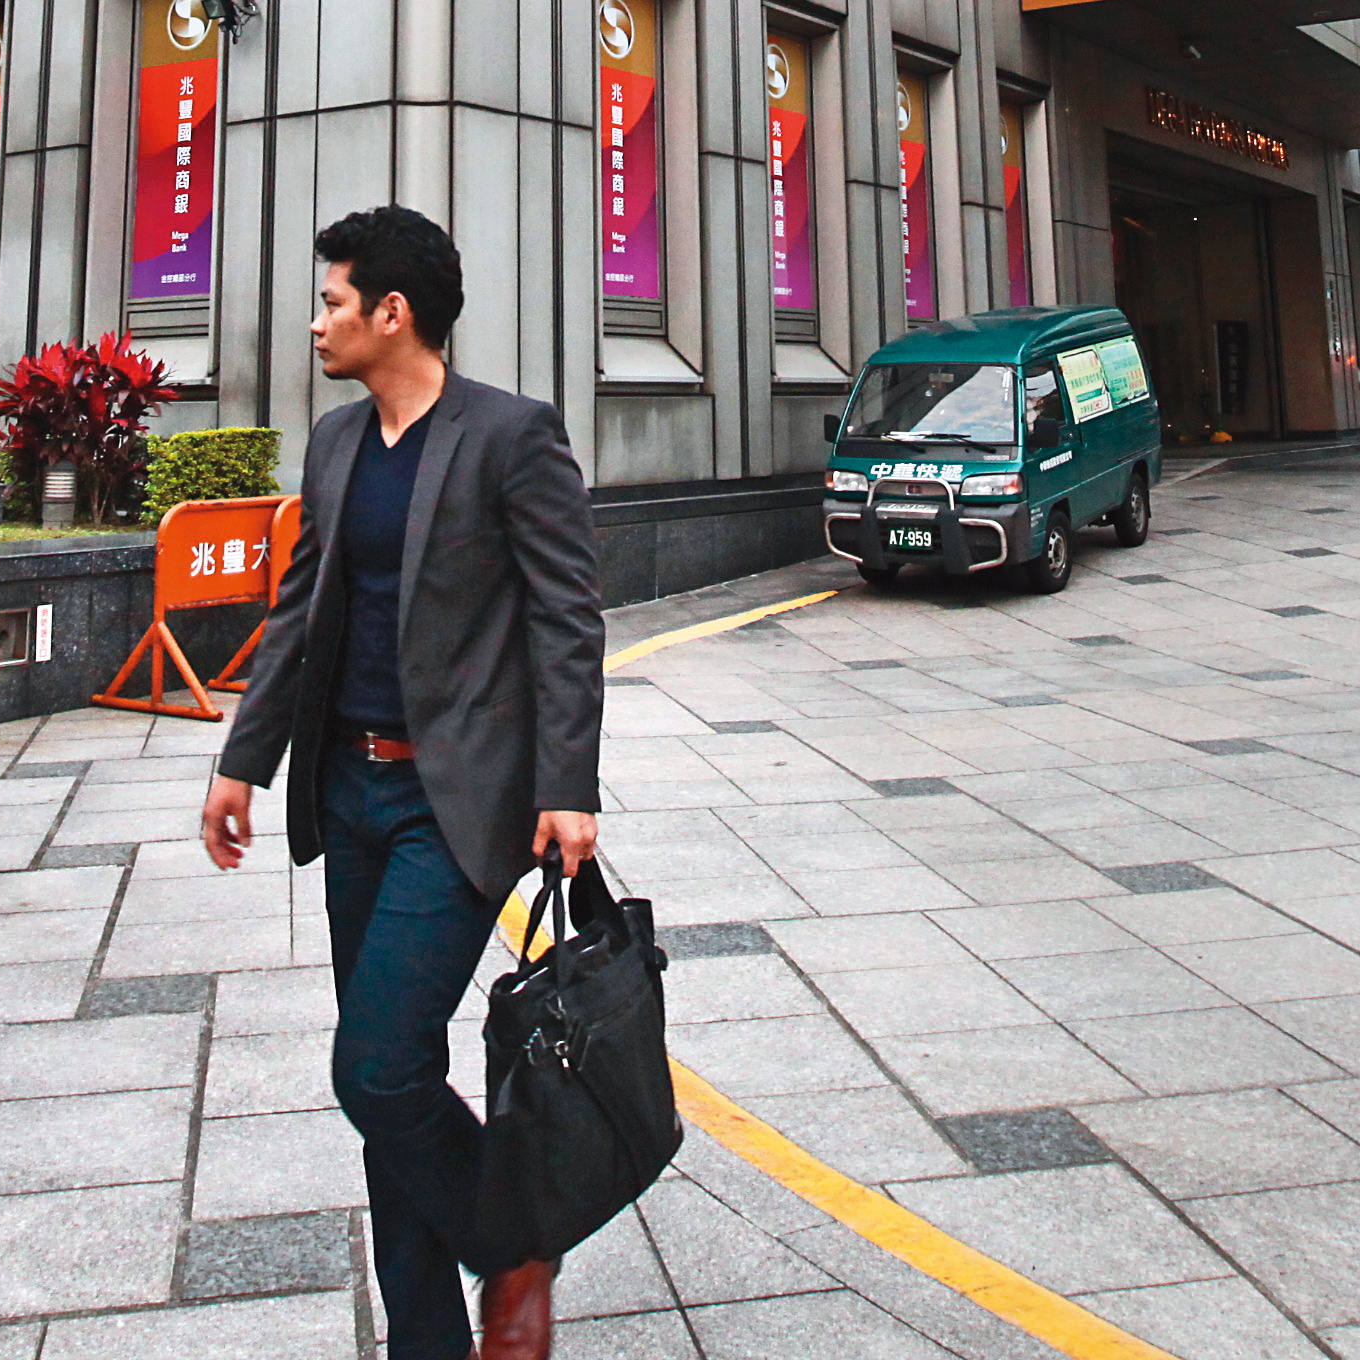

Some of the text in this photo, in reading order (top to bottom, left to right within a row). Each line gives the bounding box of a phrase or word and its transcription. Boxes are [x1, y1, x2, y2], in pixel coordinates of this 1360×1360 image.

[174, 76, 194, 214] 兆豐國際商銀
[869, 462, 964, 481] 中華快遞
[889, 529, 932, 547] A7-959
